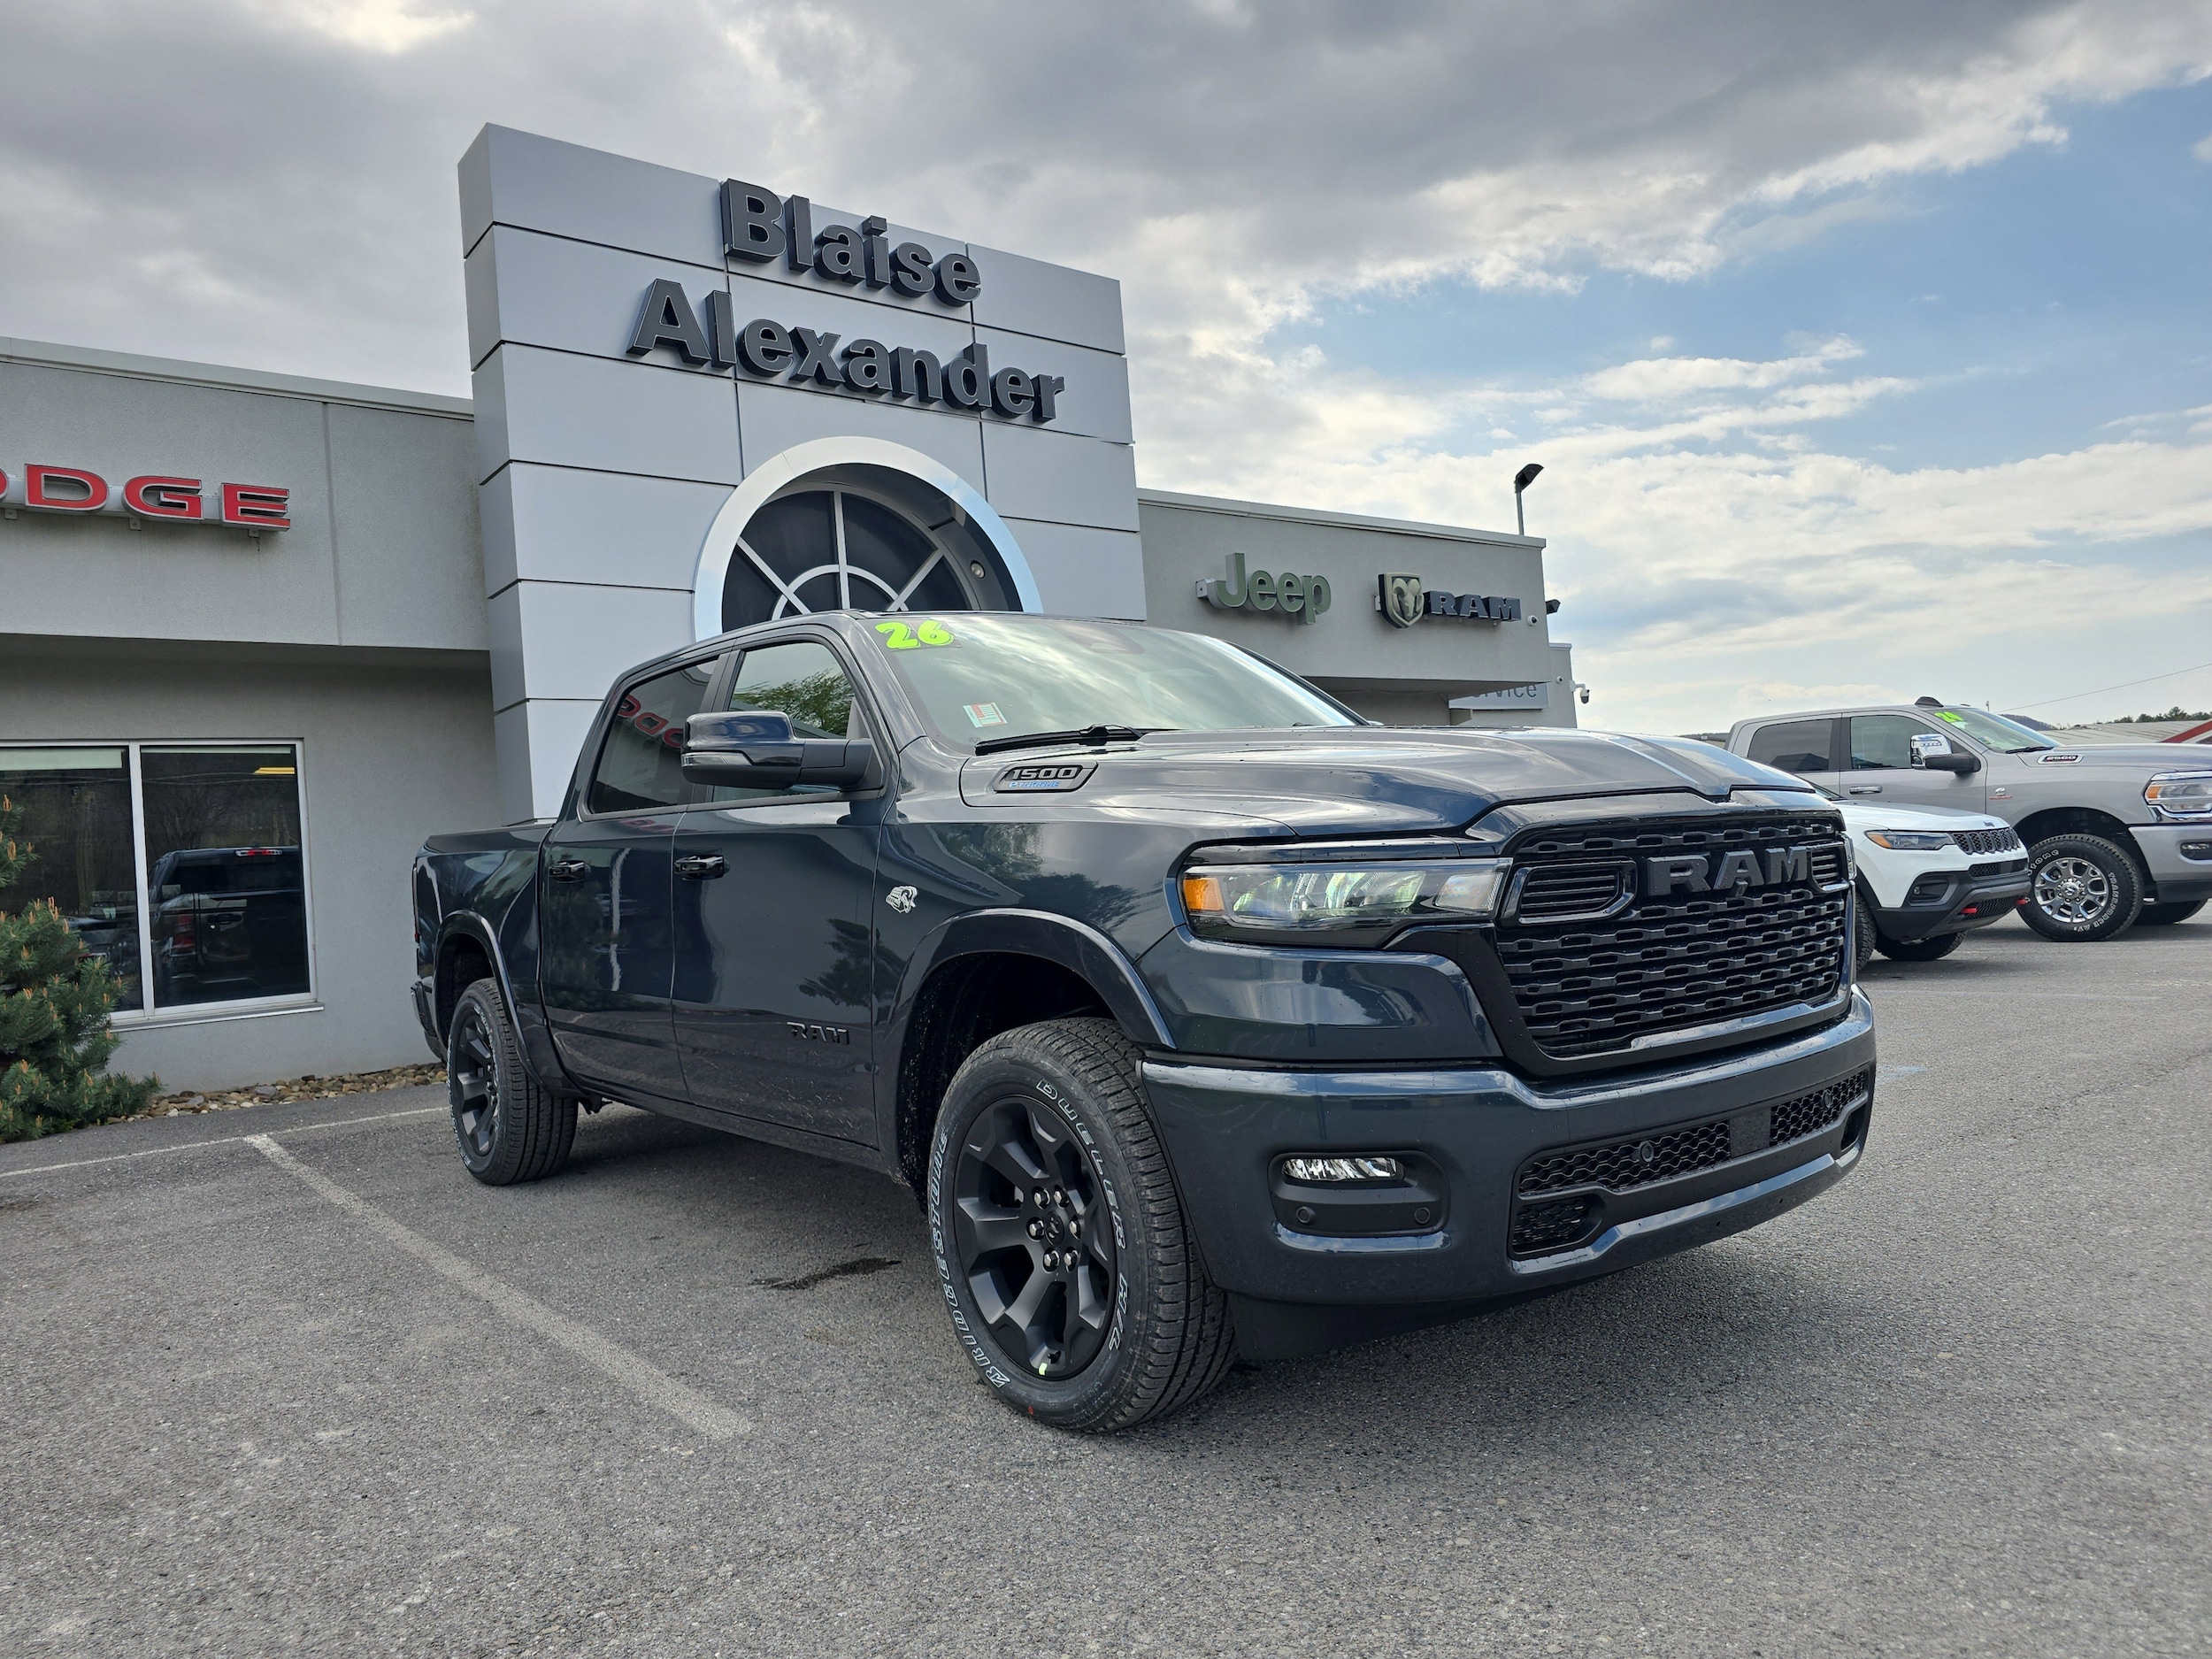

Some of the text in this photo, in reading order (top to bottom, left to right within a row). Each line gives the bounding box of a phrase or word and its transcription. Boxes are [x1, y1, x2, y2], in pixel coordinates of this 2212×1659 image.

[719, 178, 981, 307] Blaise
[626, 278, 1064, 423] Alexander
[0, 464, 290, 531] DGE
[1207, 552, 1331, 625] Jeep
[1423, 590, 1522, 622] RAM
[875, 619, 954, 649] 26
[1010, 766, 1079, 780] 1500
[1647, 847, 1809, 895] RAM
[787, 1021, 850, 1045] RAM
[1036, 1079, 1126, 1250] DUELER
[930, 1125, 1011, 1389] BRIDGESTONE
